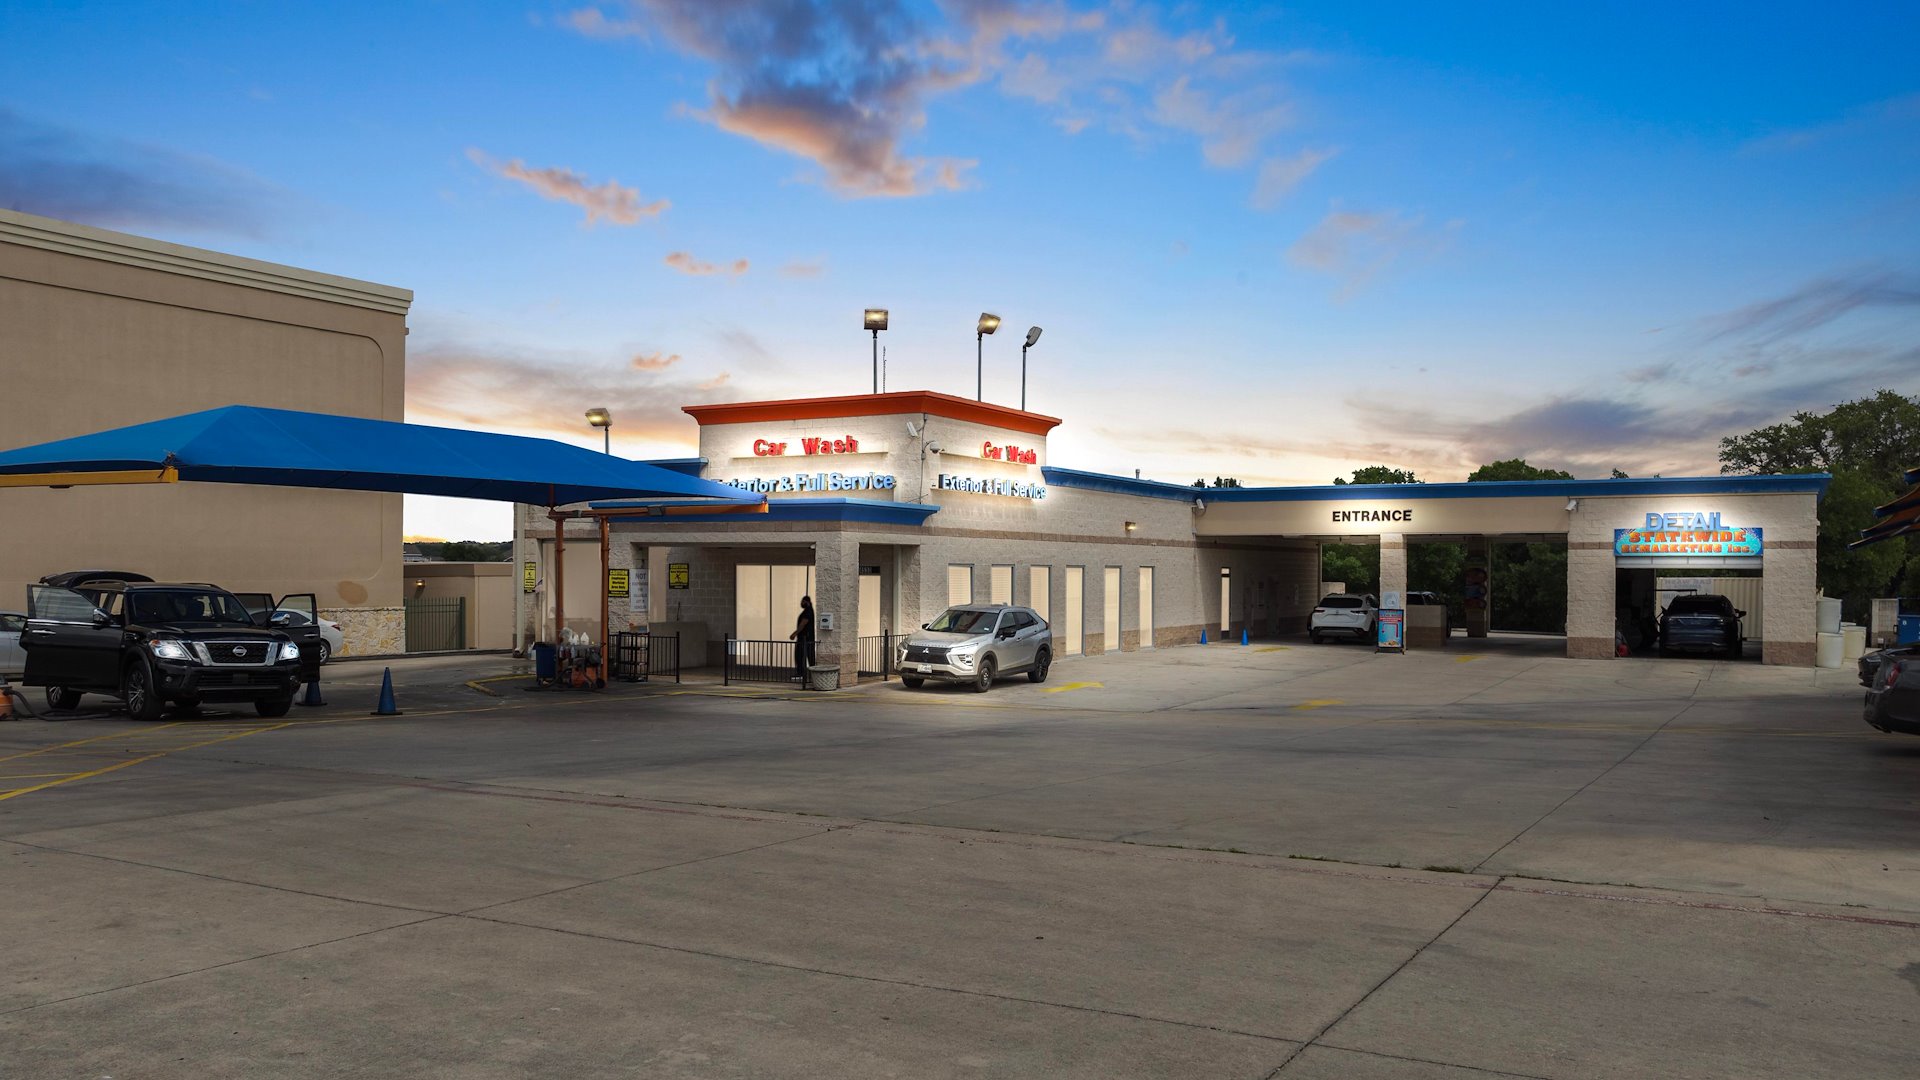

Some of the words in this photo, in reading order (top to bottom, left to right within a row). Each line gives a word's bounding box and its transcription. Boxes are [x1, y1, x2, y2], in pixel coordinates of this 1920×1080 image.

[754, 438, 786, 457] Car
[801, 434, 859, 456] Wash
[982, 441, 1003, 460] Car
[1006, 445, 1037, 465] Wash
[780, 476, 794, 492] &
[796, 473, 828, 492] Full
[829, 471, 897, 491] Service
[939, 474, 984, 494] Exterior
[984, 480, 994, 495] &
[994, 478, 1012, 496] Full
[1012, 480, 1047, 499] Service
[1332, 509, 1413, 522] ENTRANCE
[1645, 511, 1730, 531] DETAIL
[1629, 531, 1747, 543] STATEWIDE
[1621, 544, 1722, 554] REMARKETING
